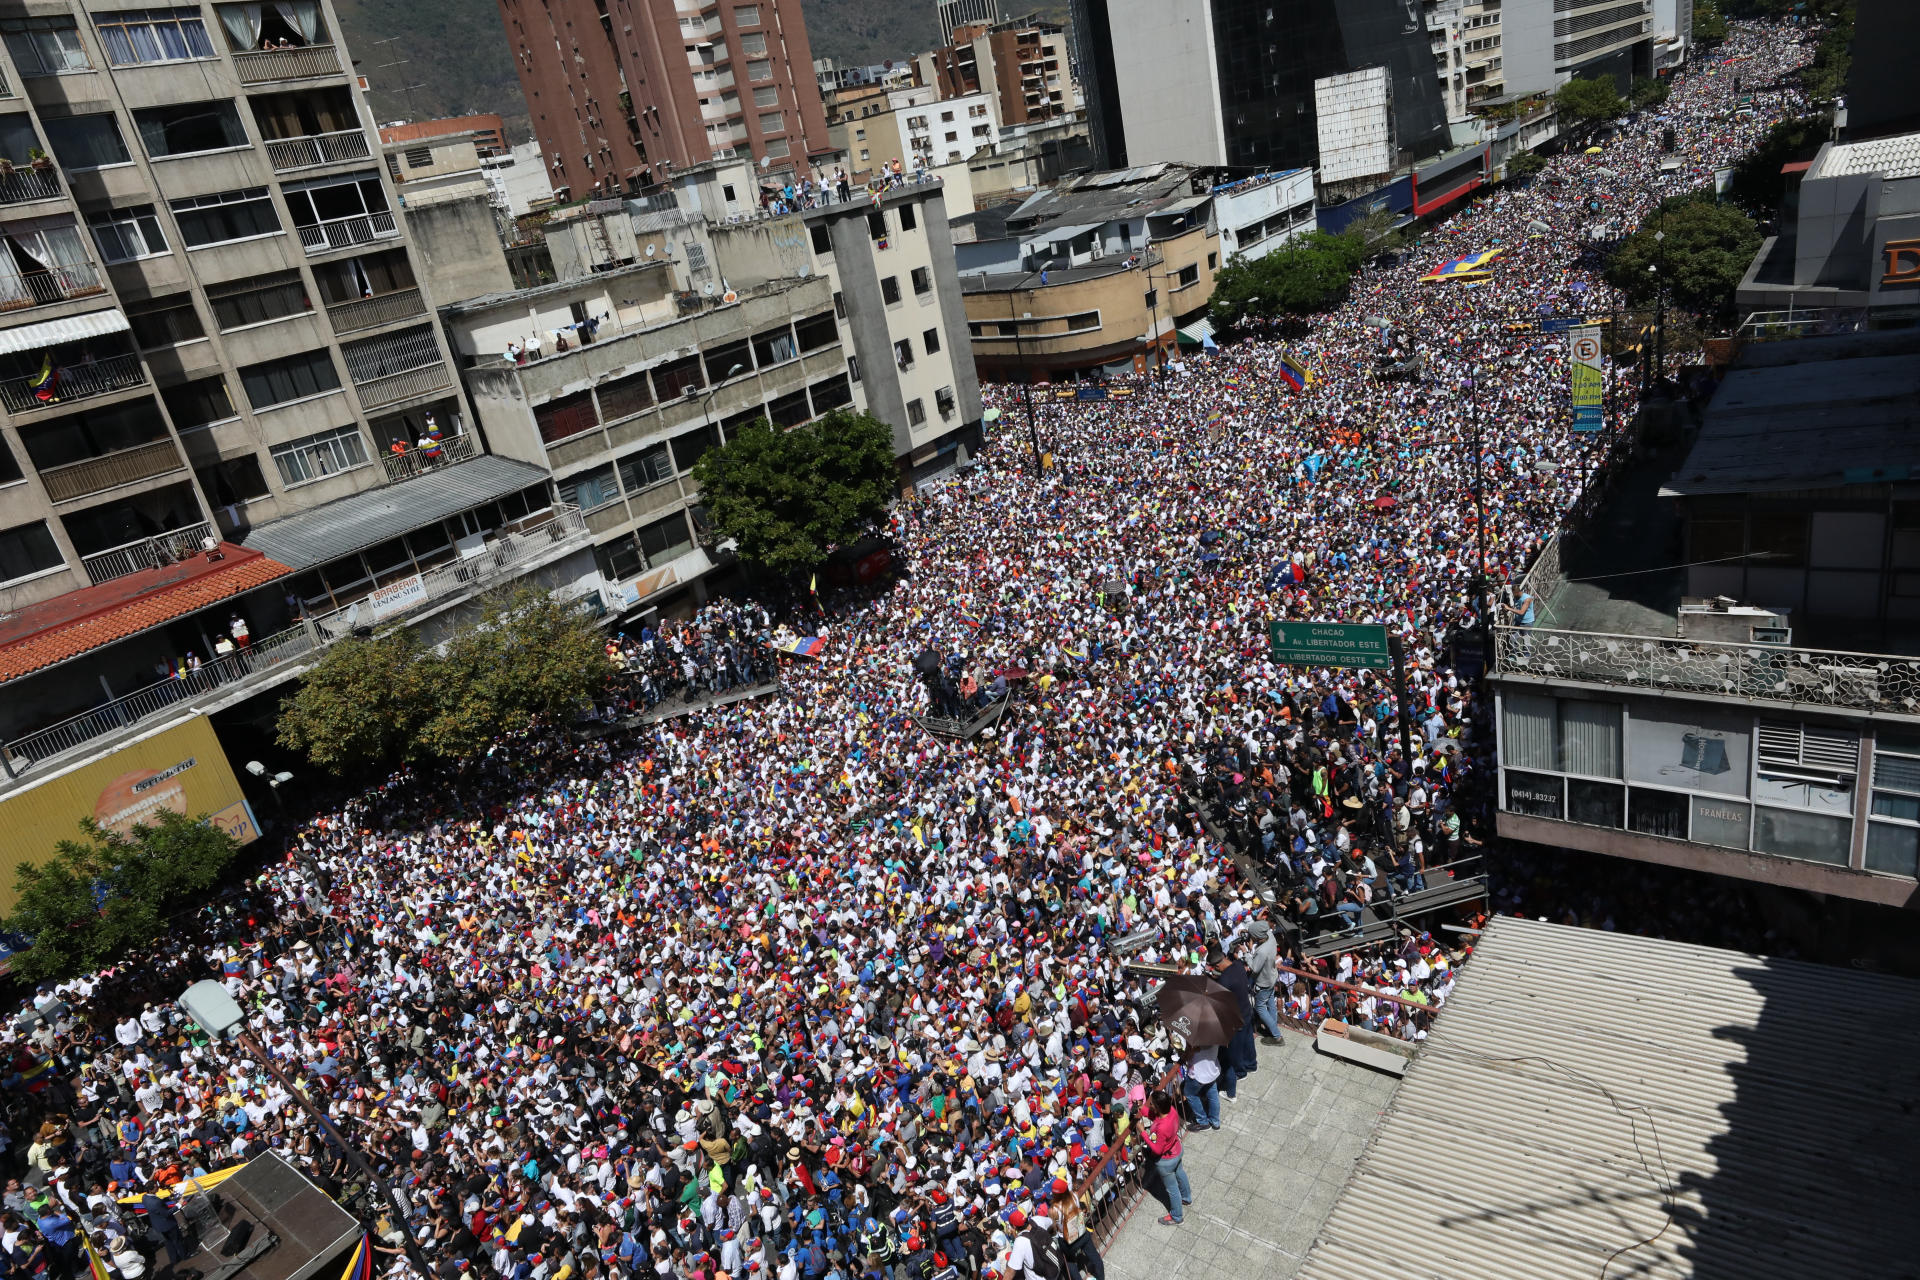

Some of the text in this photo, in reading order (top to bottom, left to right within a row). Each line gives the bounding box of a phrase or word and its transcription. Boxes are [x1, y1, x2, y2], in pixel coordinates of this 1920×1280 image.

[1311, 628, 1345, 636] CHACAO
[1306, 639, 1356, 648] LIBERTADOR
[1359, 641, 1381, 649] ESTE
[1289, 653, 1337, 662] LIBERTADOR
[1340, 655, 1367, 664] OESTE
[1699, 807, 1743, 823] FRANELAS
